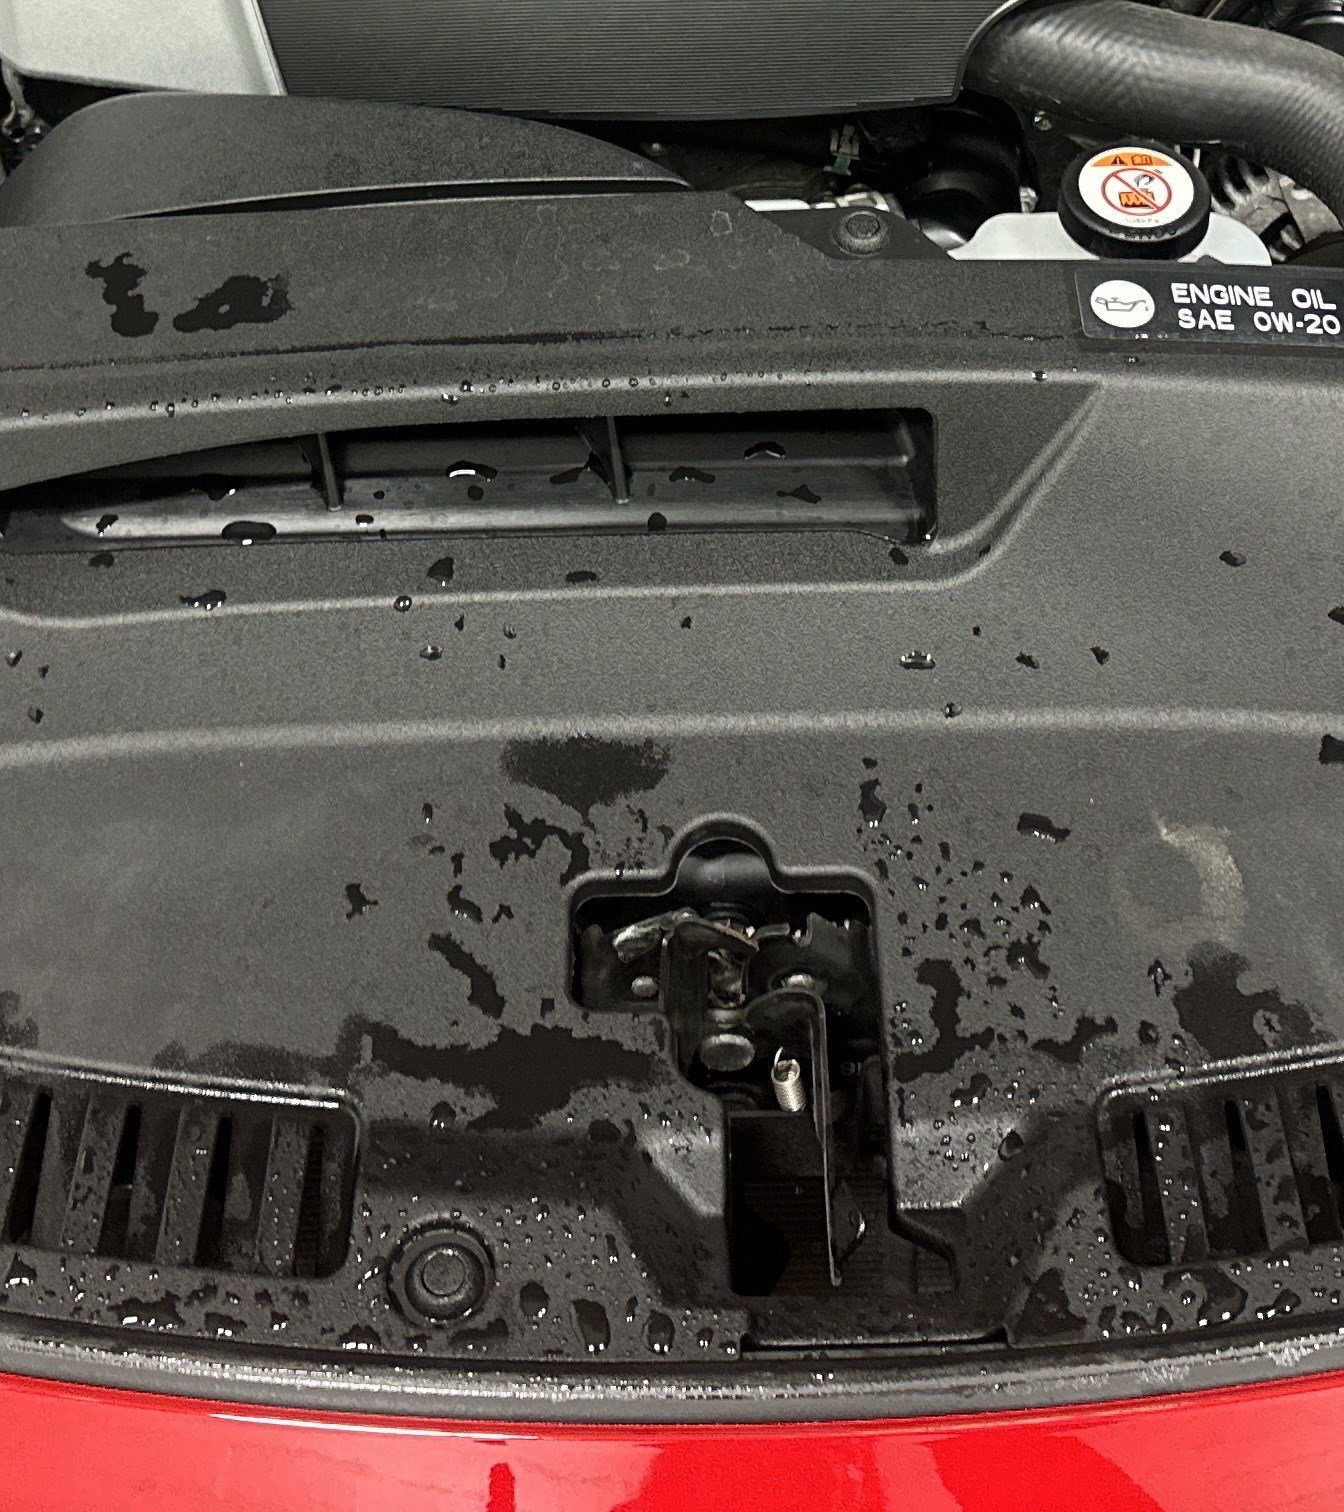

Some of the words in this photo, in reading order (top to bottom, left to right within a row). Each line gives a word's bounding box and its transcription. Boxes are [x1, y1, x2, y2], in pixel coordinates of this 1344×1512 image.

[1170, 282, 1274, 308] ENGINE
[1291, 287, 1338, 310] OIL
[1177, 309, 1235, 332] SAE
[1253, 311, 1342, 336] 0W-20
